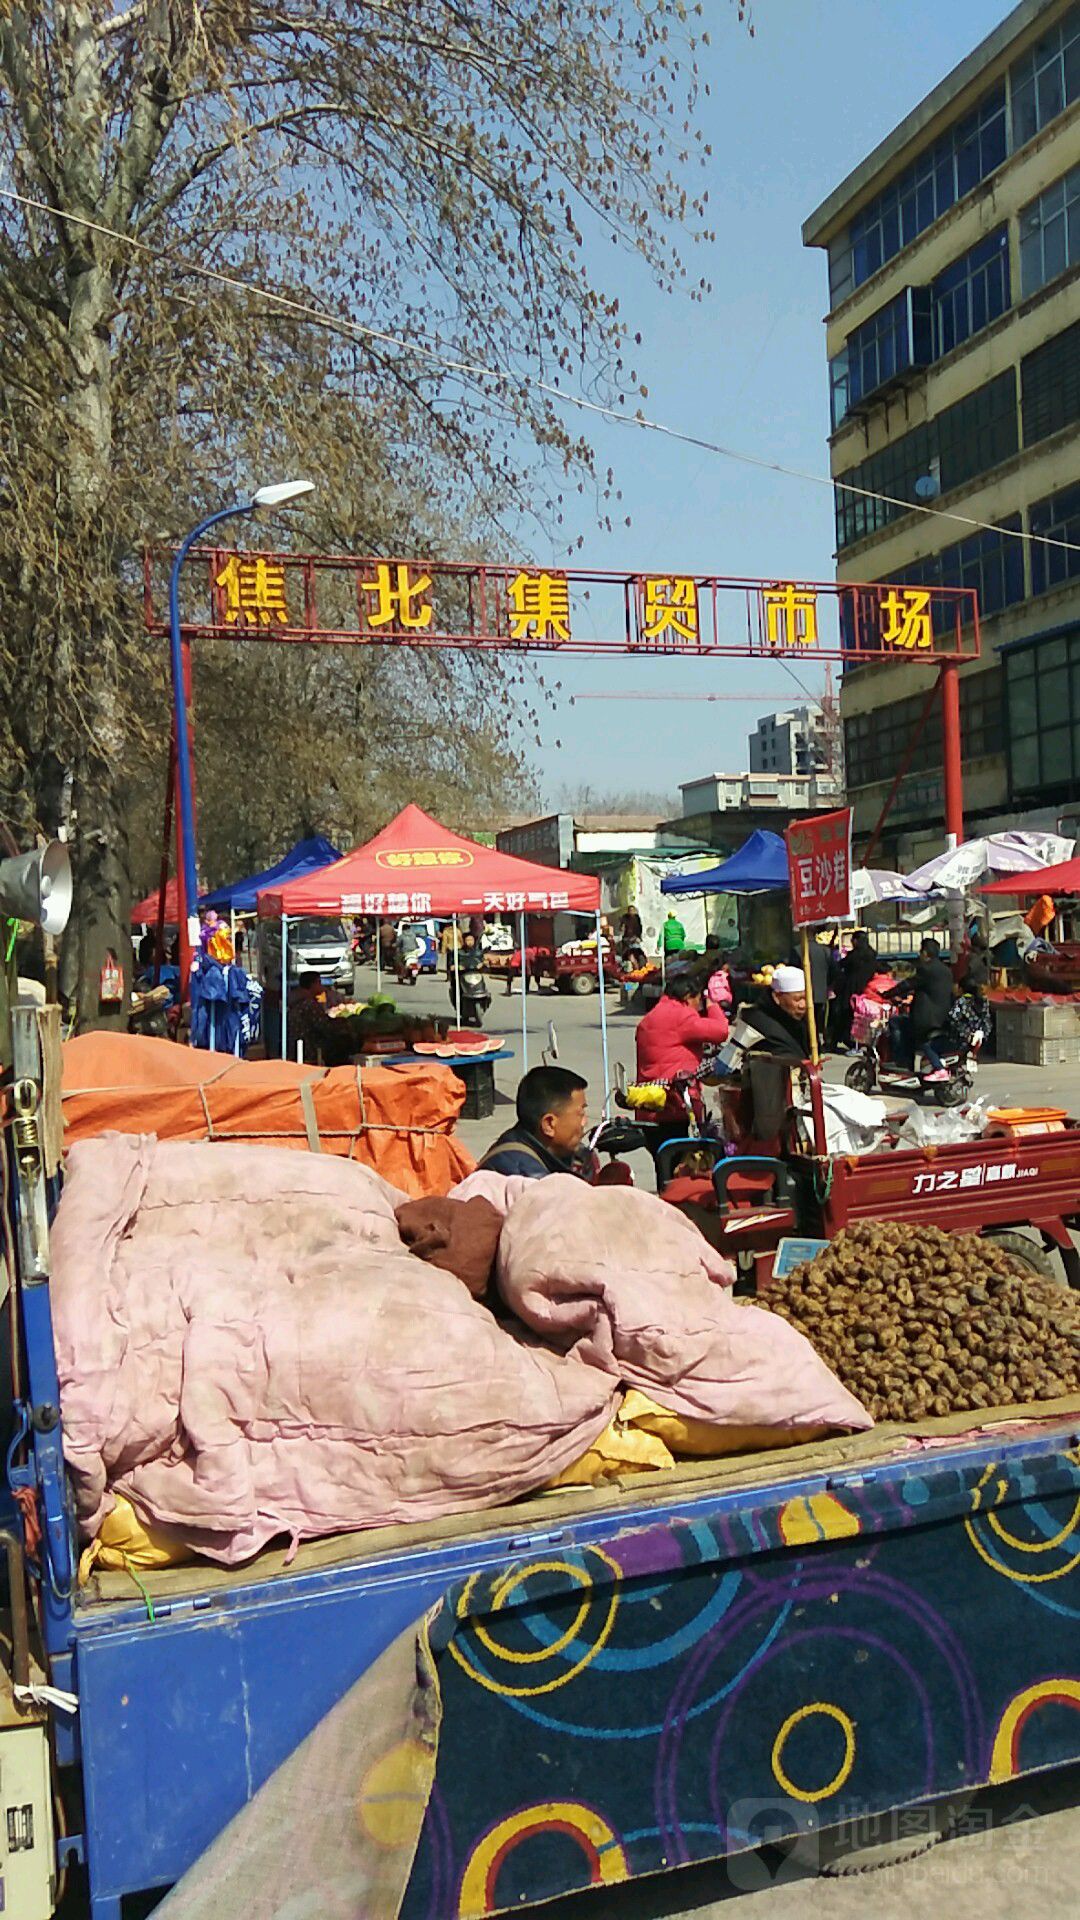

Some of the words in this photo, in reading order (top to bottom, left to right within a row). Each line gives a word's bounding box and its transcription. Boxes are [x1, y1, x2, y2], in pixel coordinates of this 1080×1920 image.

[215, 555, 932, 649] 焦北集贸市场
